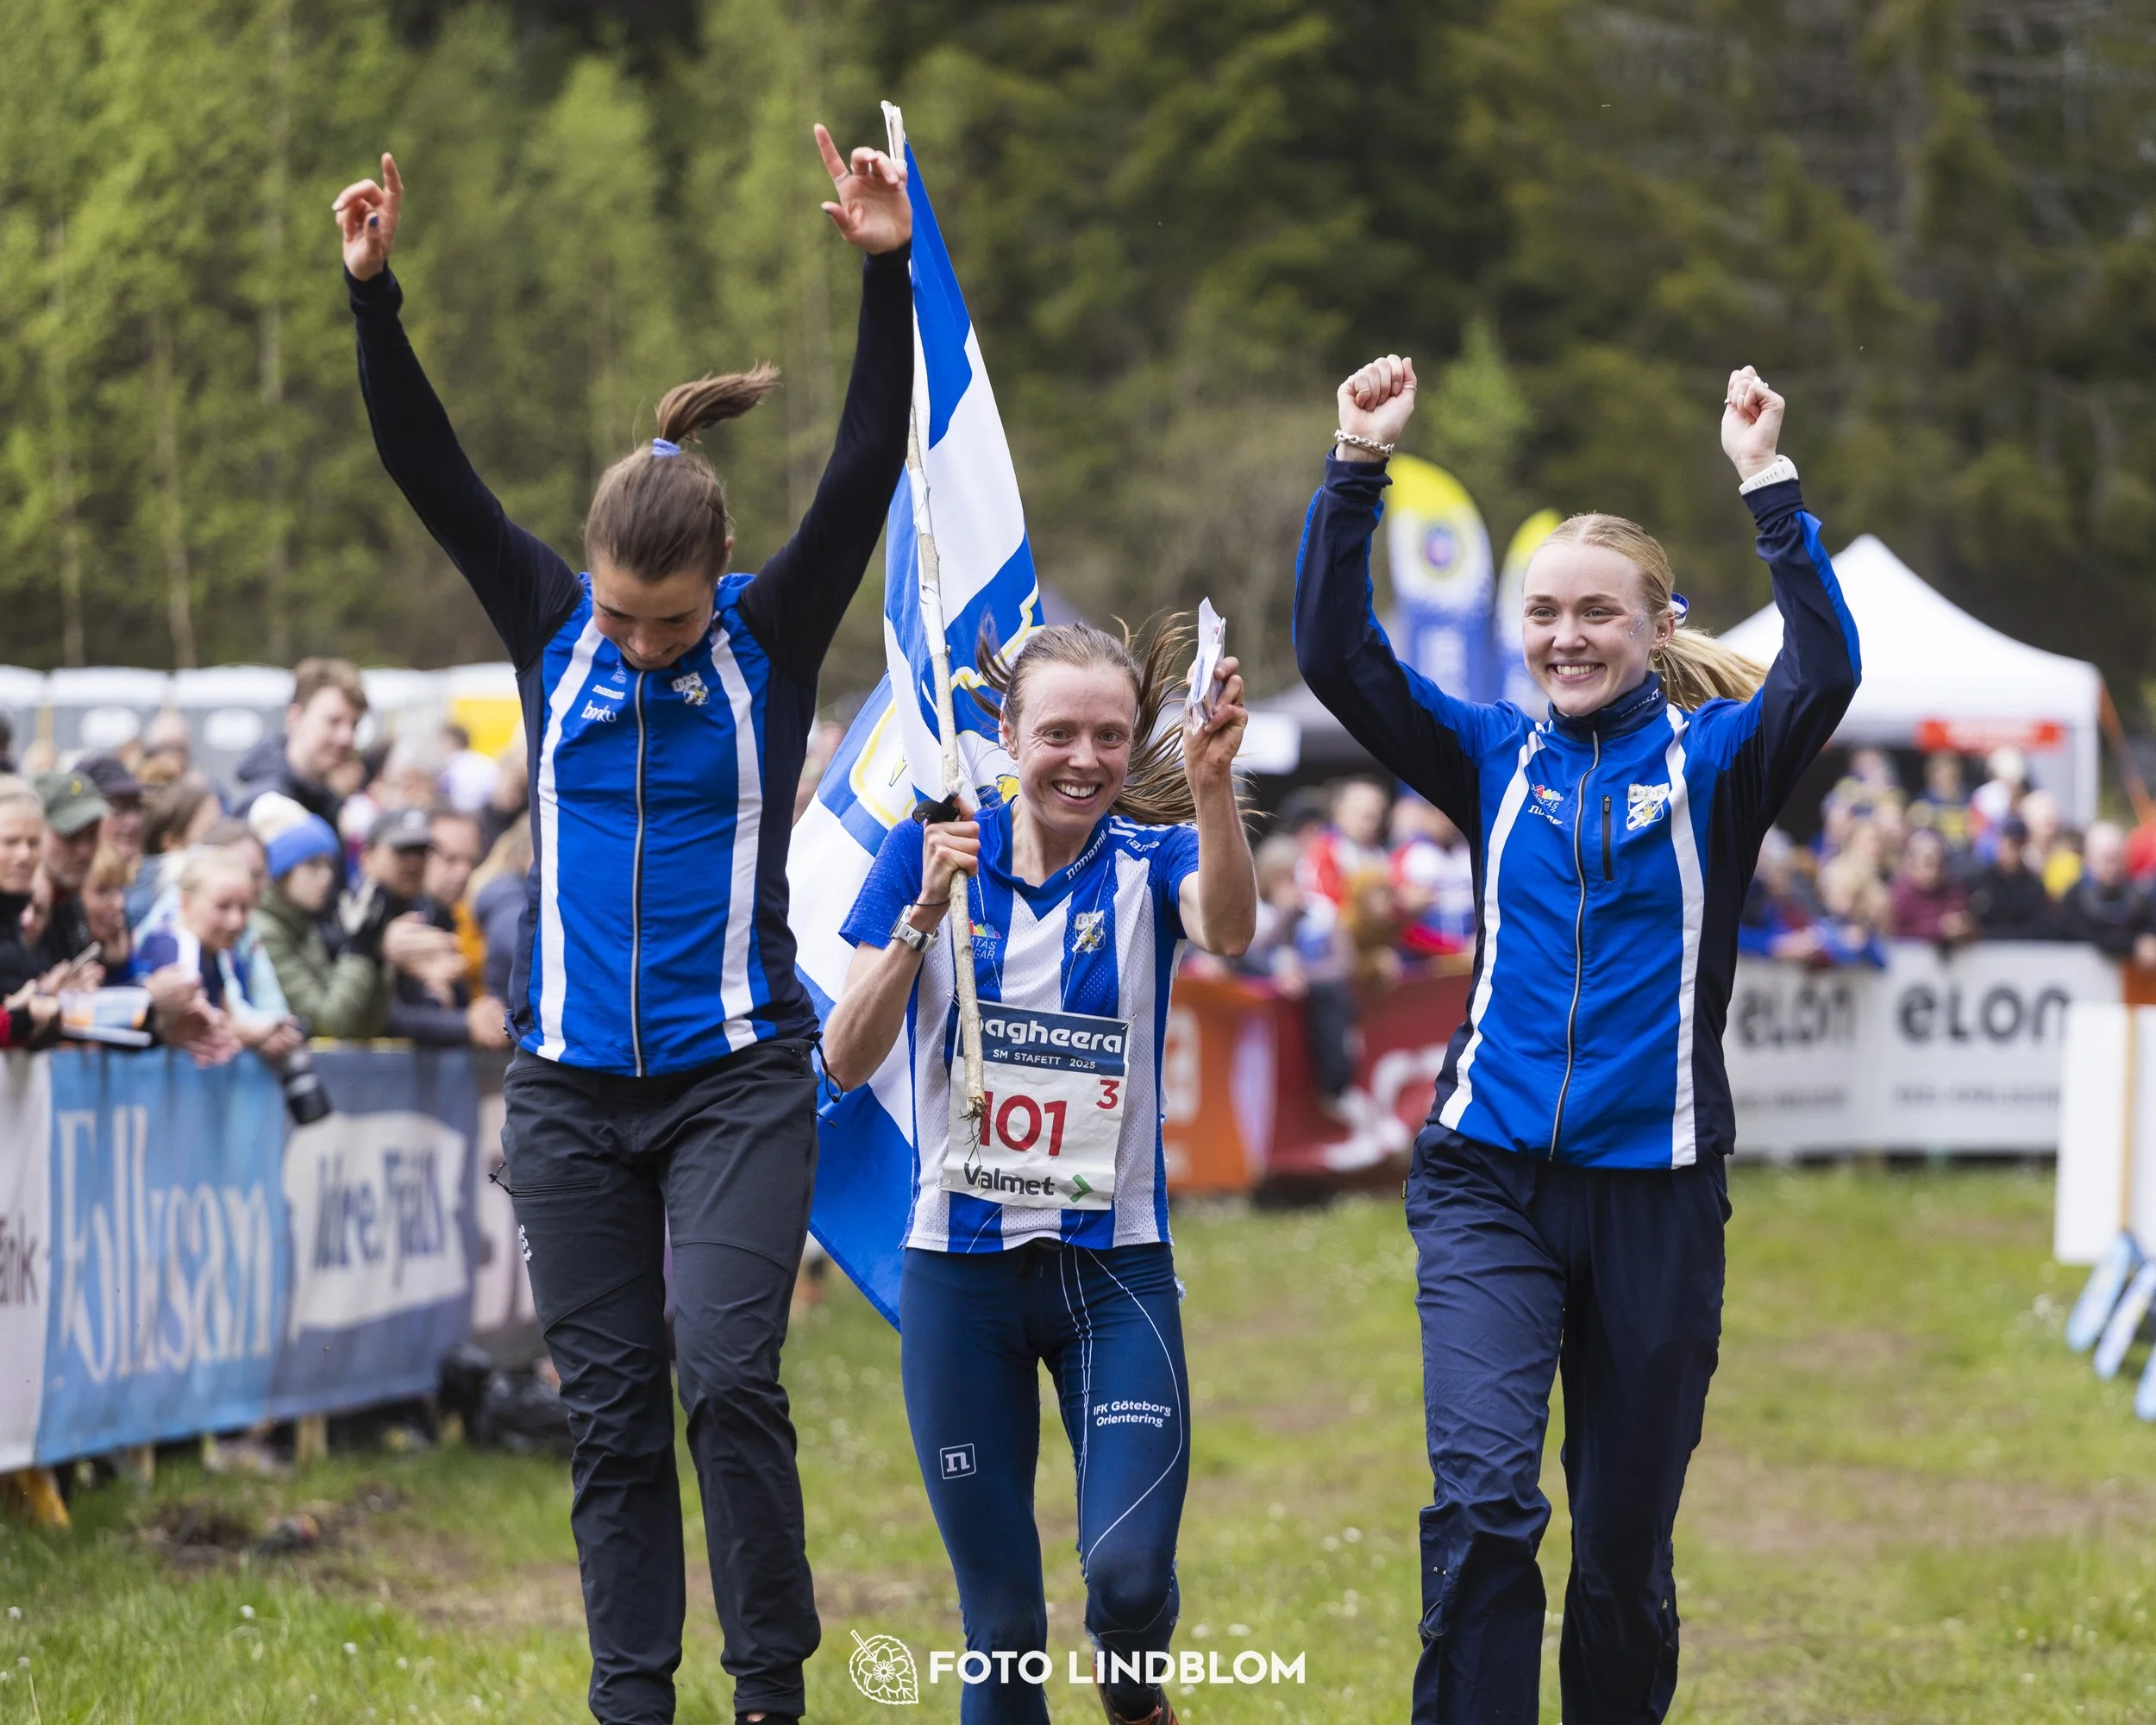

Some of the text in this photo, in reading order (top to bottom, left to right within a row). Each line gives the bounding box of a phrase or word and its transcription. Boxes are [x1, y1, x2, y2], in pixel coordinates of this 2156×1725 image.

[981, 1019, 1123, 1054] agheera
[993, 1049, 1096, 1070] SM STAFETT 2025
[1096, 1079, 1120, 1110] 3
[980, 1090, 1068, 1157] 101
[963, 1162, 1056, 1196] Valmet
[1093, 1400, 1172, 1417] IFK Göteborg
[1096, 1414, 1164, 1428] Orientering
